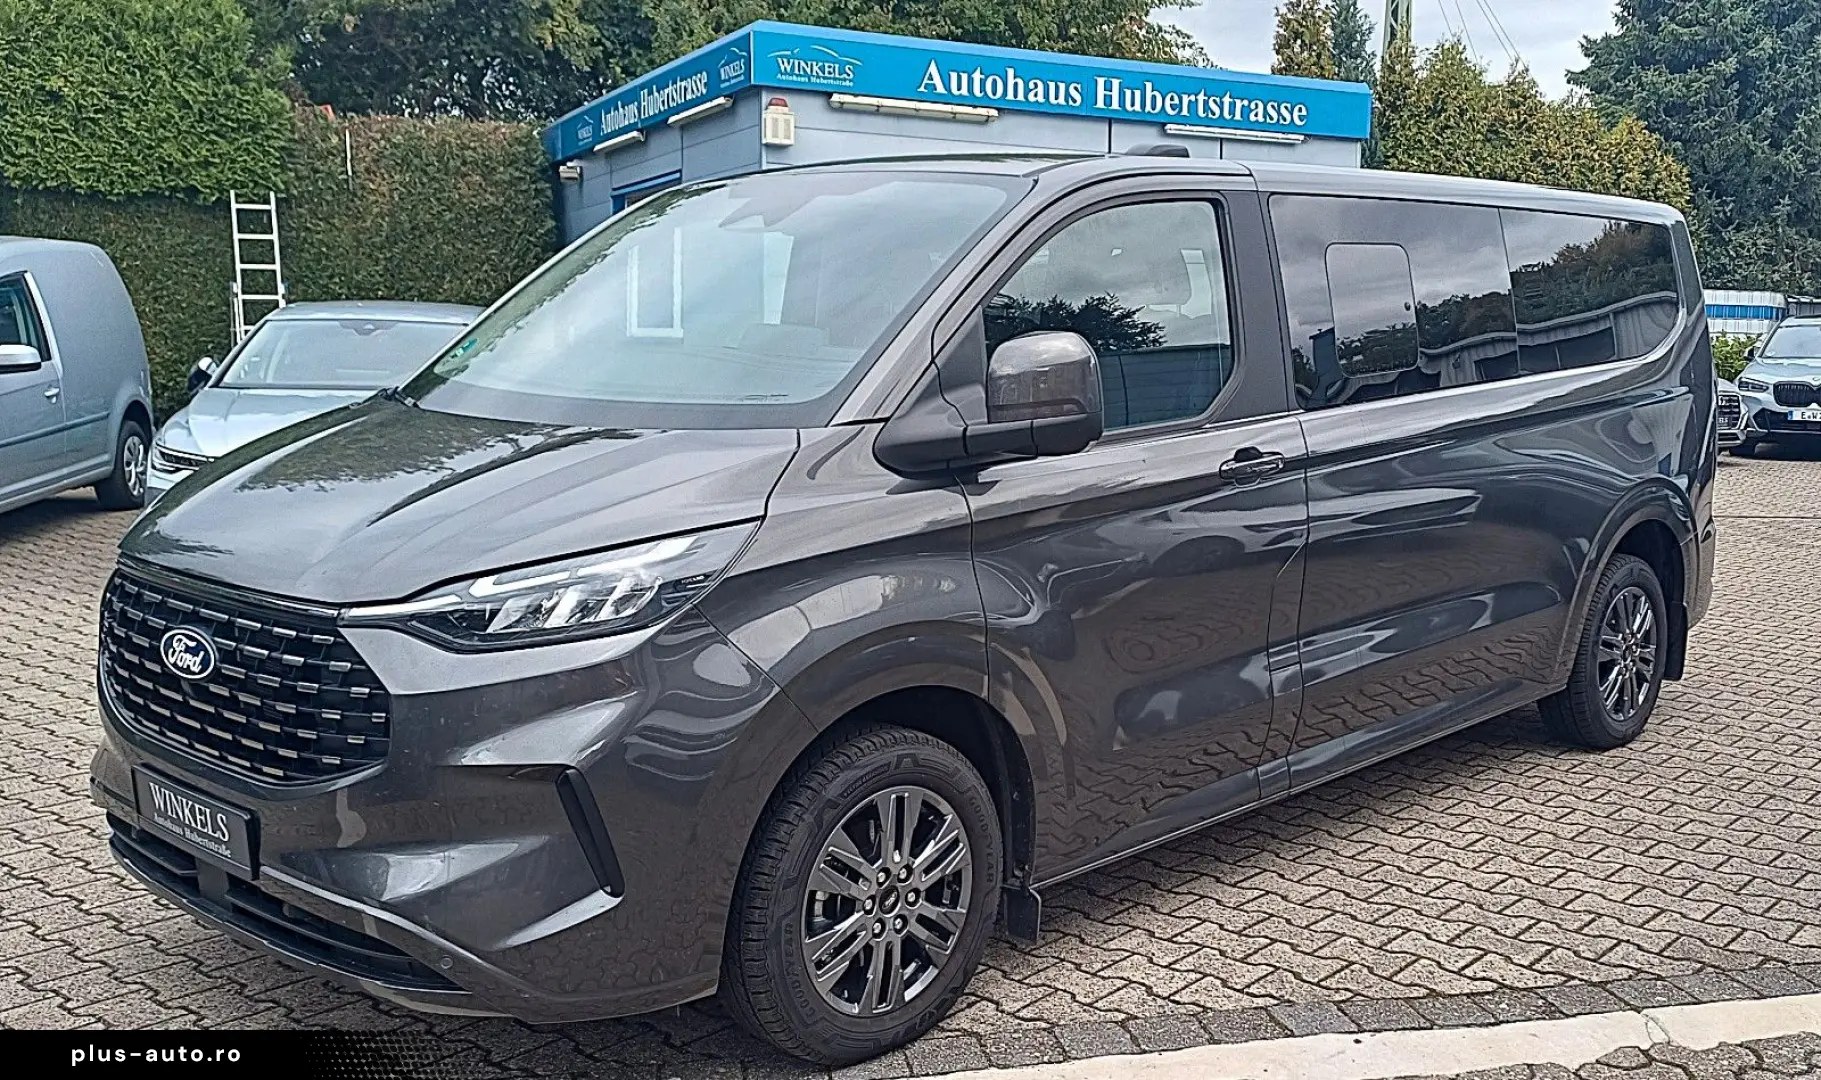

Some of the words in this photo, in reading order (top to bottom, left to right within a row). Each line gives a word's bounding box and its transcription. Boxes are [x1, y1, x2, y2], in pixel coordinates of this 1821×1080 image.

[777, 57, 854, 79] WINKELS
[917, 59, 1083, 107] Autohaus
[1093, 76, 1308, 126] Hubertstrasse
[600, 99, 639, 135] Autohaus
[640, 70, 708, 119] Hubertstrasse
[168, 634, 205, 673] Ford
[148, 782, 230, 841] WINKELS
